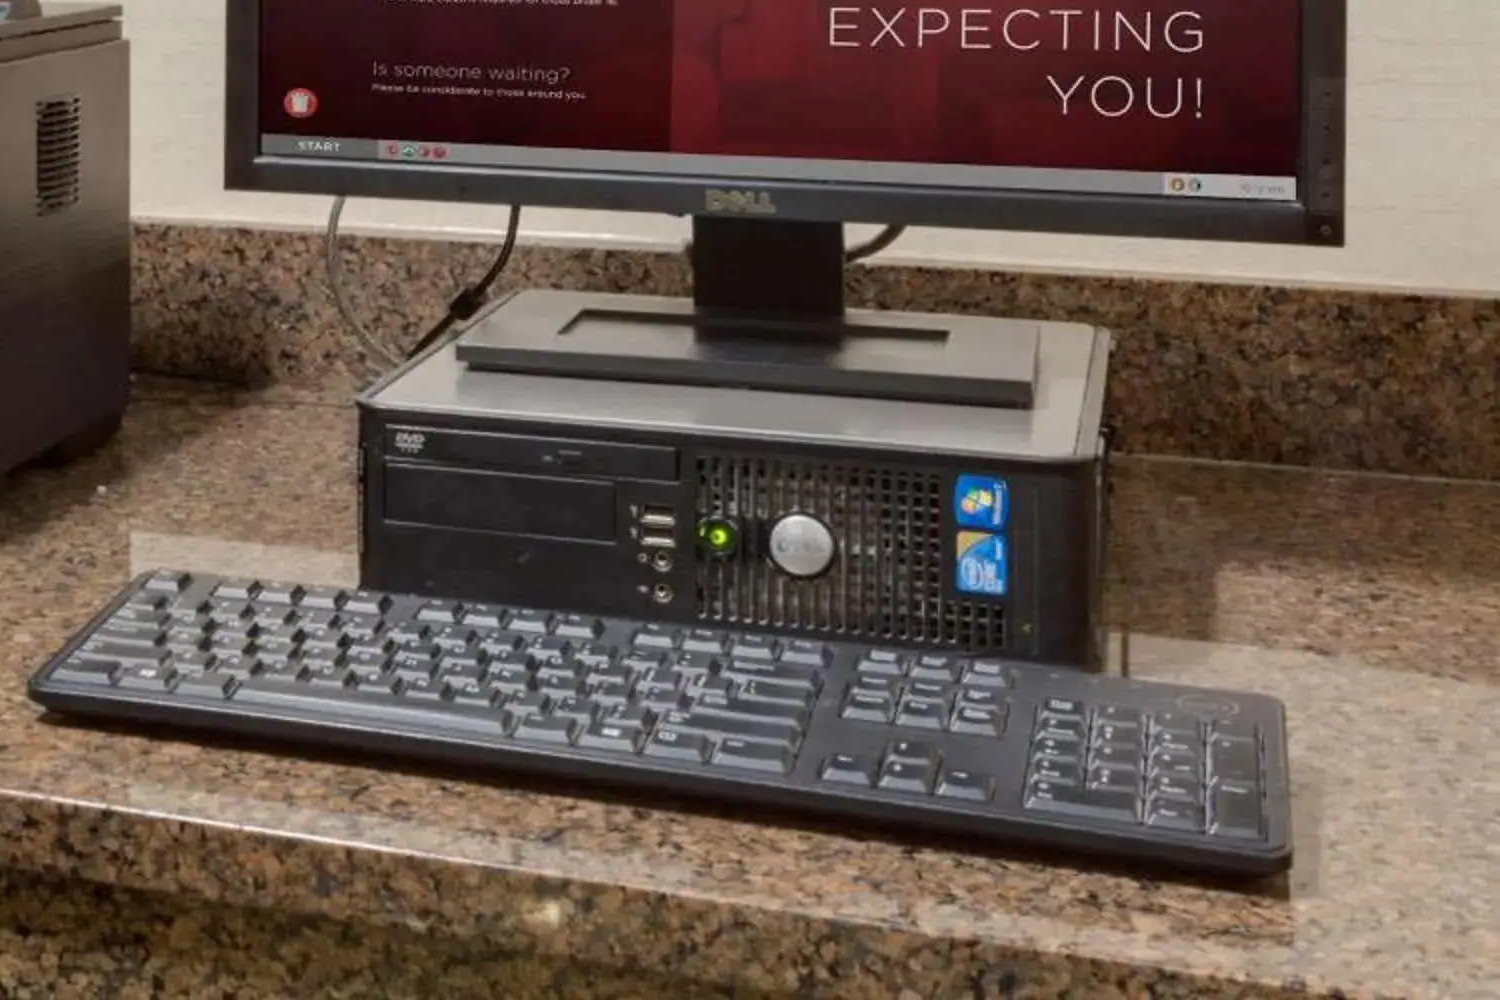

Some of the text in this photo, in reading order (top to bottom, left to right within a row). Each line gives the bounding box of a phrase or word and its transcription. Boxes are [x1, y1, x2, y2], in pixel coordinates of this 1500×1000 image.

[828, 7, 1205, 53] EXPECTING
[373, 60, 571, 86] Is someone waiting?
[1046, 75, 1204, 119] YOU!
[298, 140, 341, 152] START
